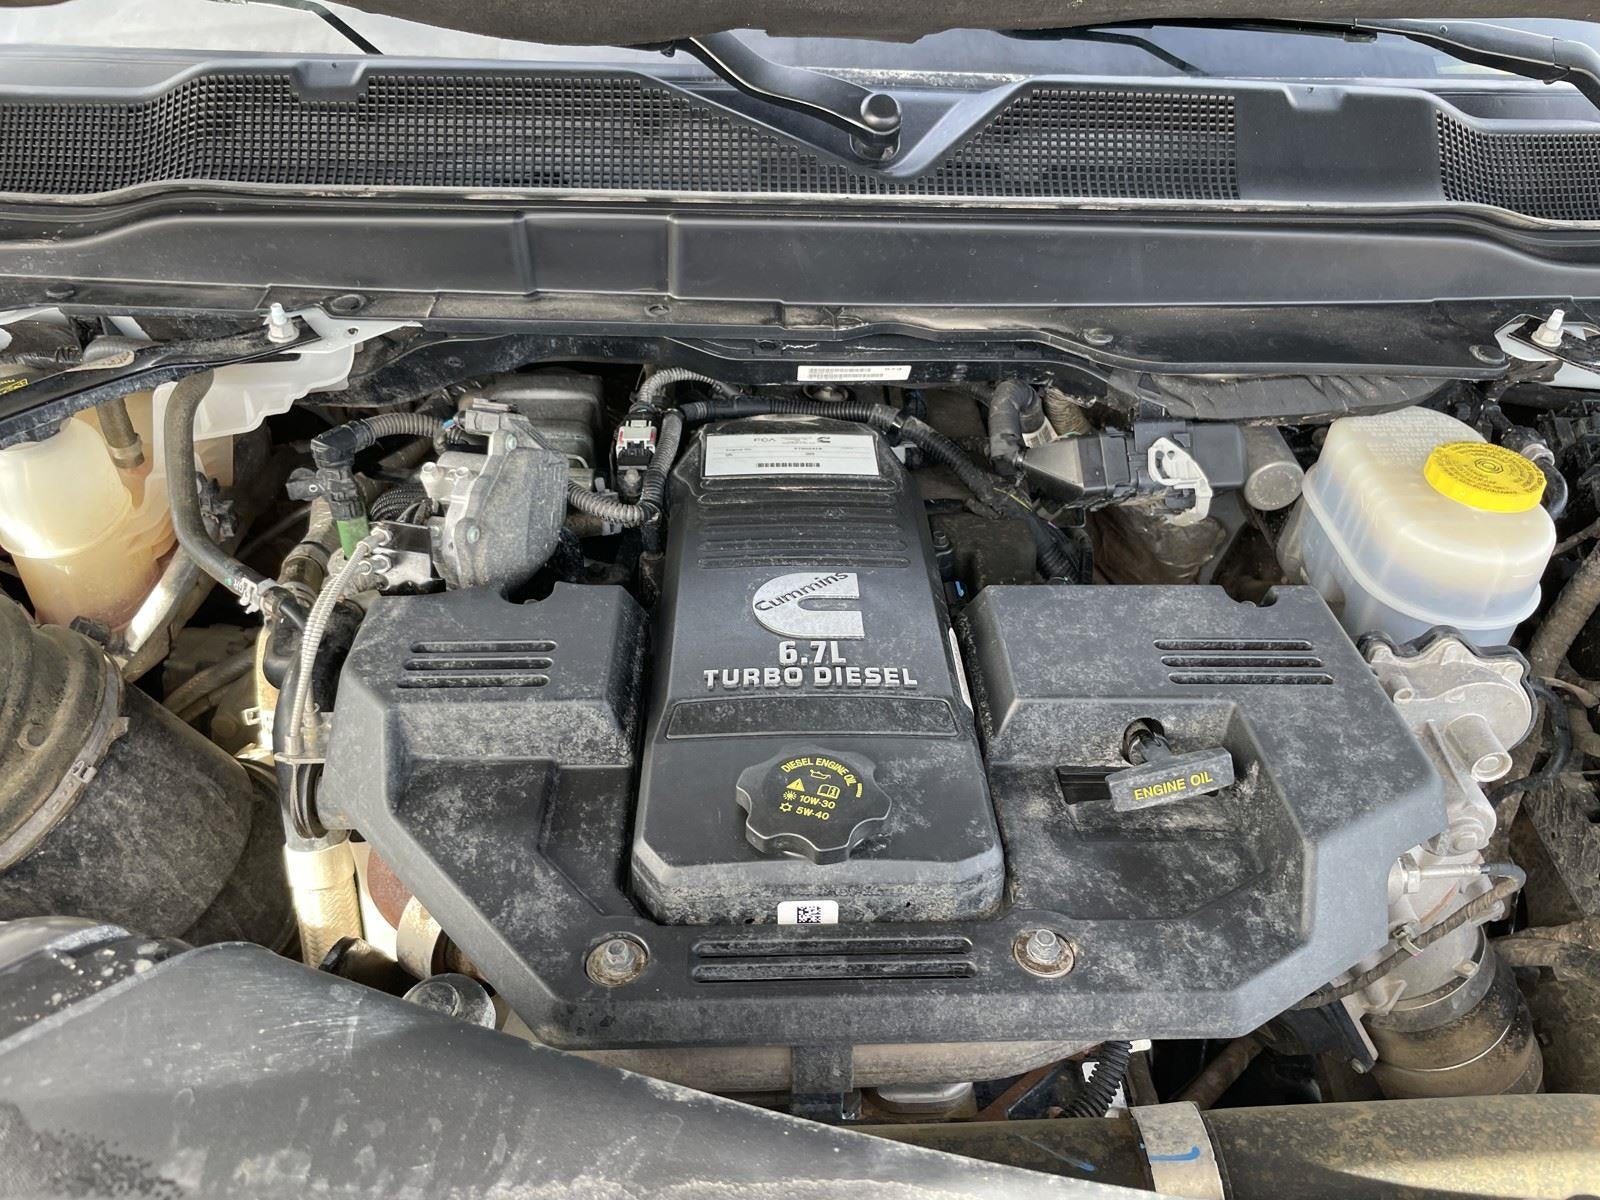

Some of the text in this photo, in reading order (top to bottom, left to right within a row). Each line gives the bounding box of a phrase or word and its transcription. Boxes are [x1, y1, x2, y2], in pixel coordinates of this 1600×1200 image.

[755, 573, 848, 611] Cummins
[779, 640, 846, 665] 6.7L
[704, 667, 917, 689] TURBO DIESEL
[781, 758, 856, 786] DIESEL ENGINE OIL
[1134, 772, 1213, 800] ENGINE OIL
[796, 807, 829, 820] 5W-40
[800, 795, 835, 809] 10W-30
